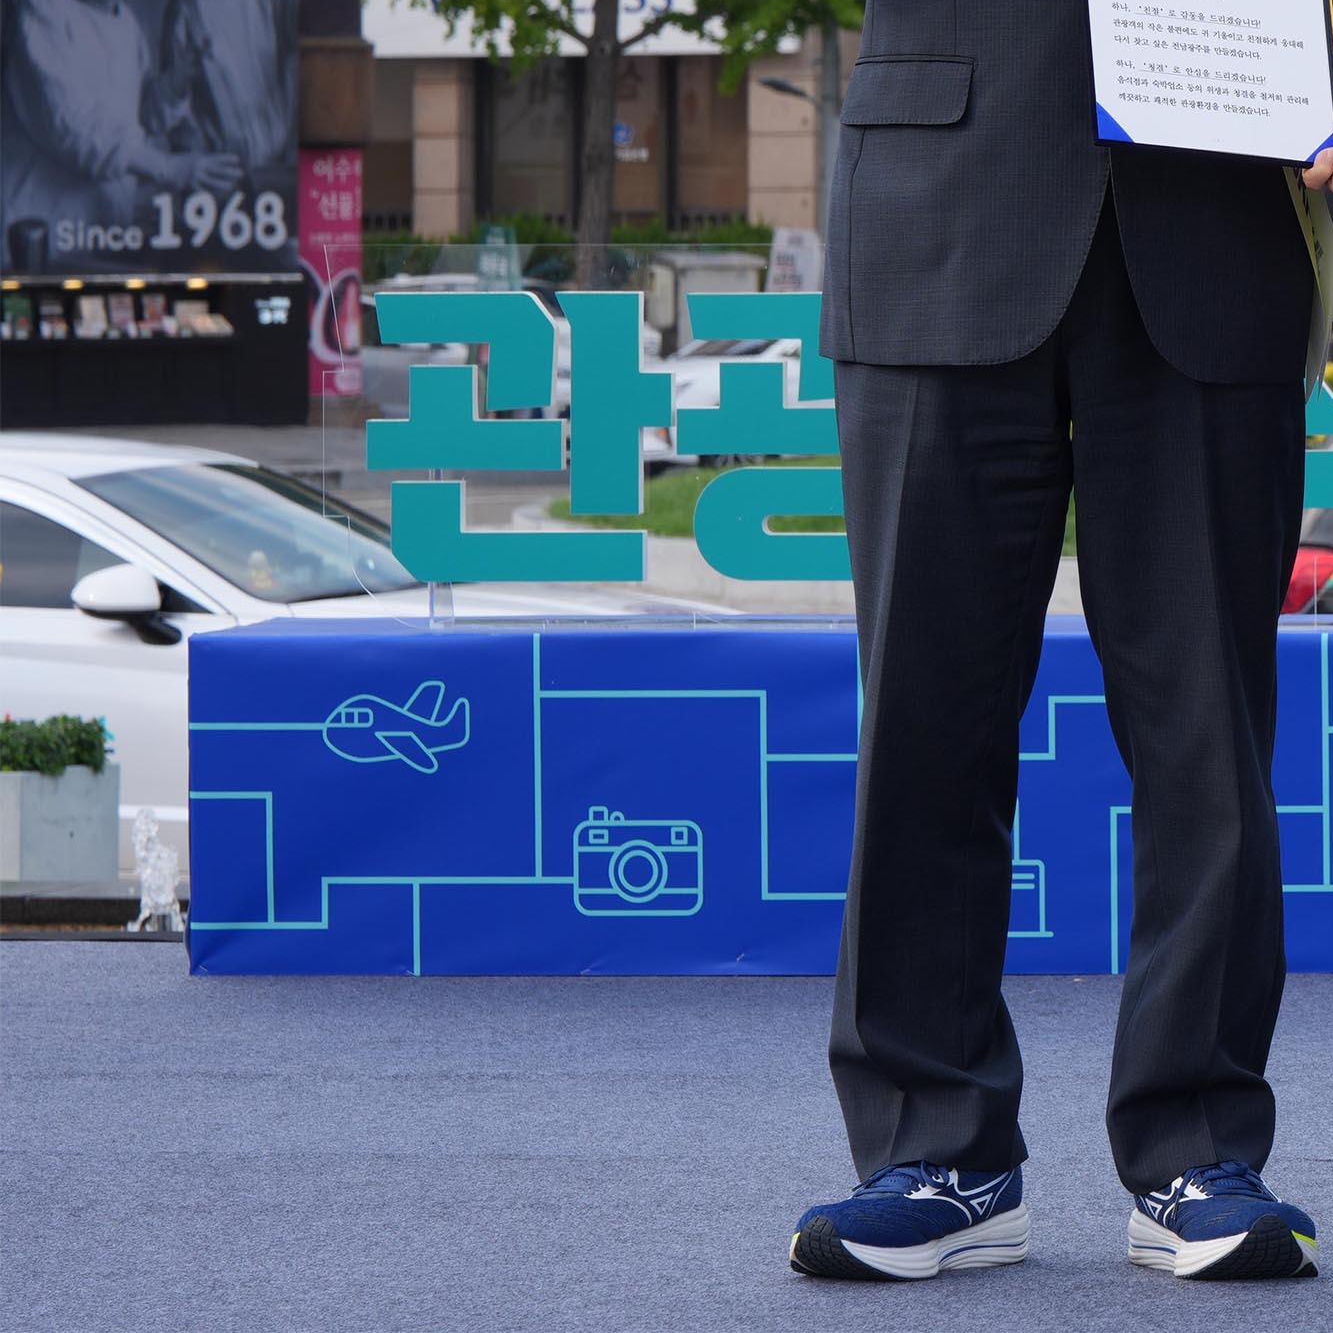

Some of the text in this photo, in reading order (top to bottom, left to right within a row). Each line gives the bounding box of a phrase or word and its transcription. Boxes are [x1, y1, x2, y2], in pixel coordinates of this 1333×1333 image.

[1113, 34, 1262, 59] 다시 찾고 싶은 전남광주를 만들겠습니다.
[1118, 92, 1270, 116] 깨끗하고 쾌적한 관광환경을 만들겠습니다.
[56, 190, 288, 252] Since 1968
